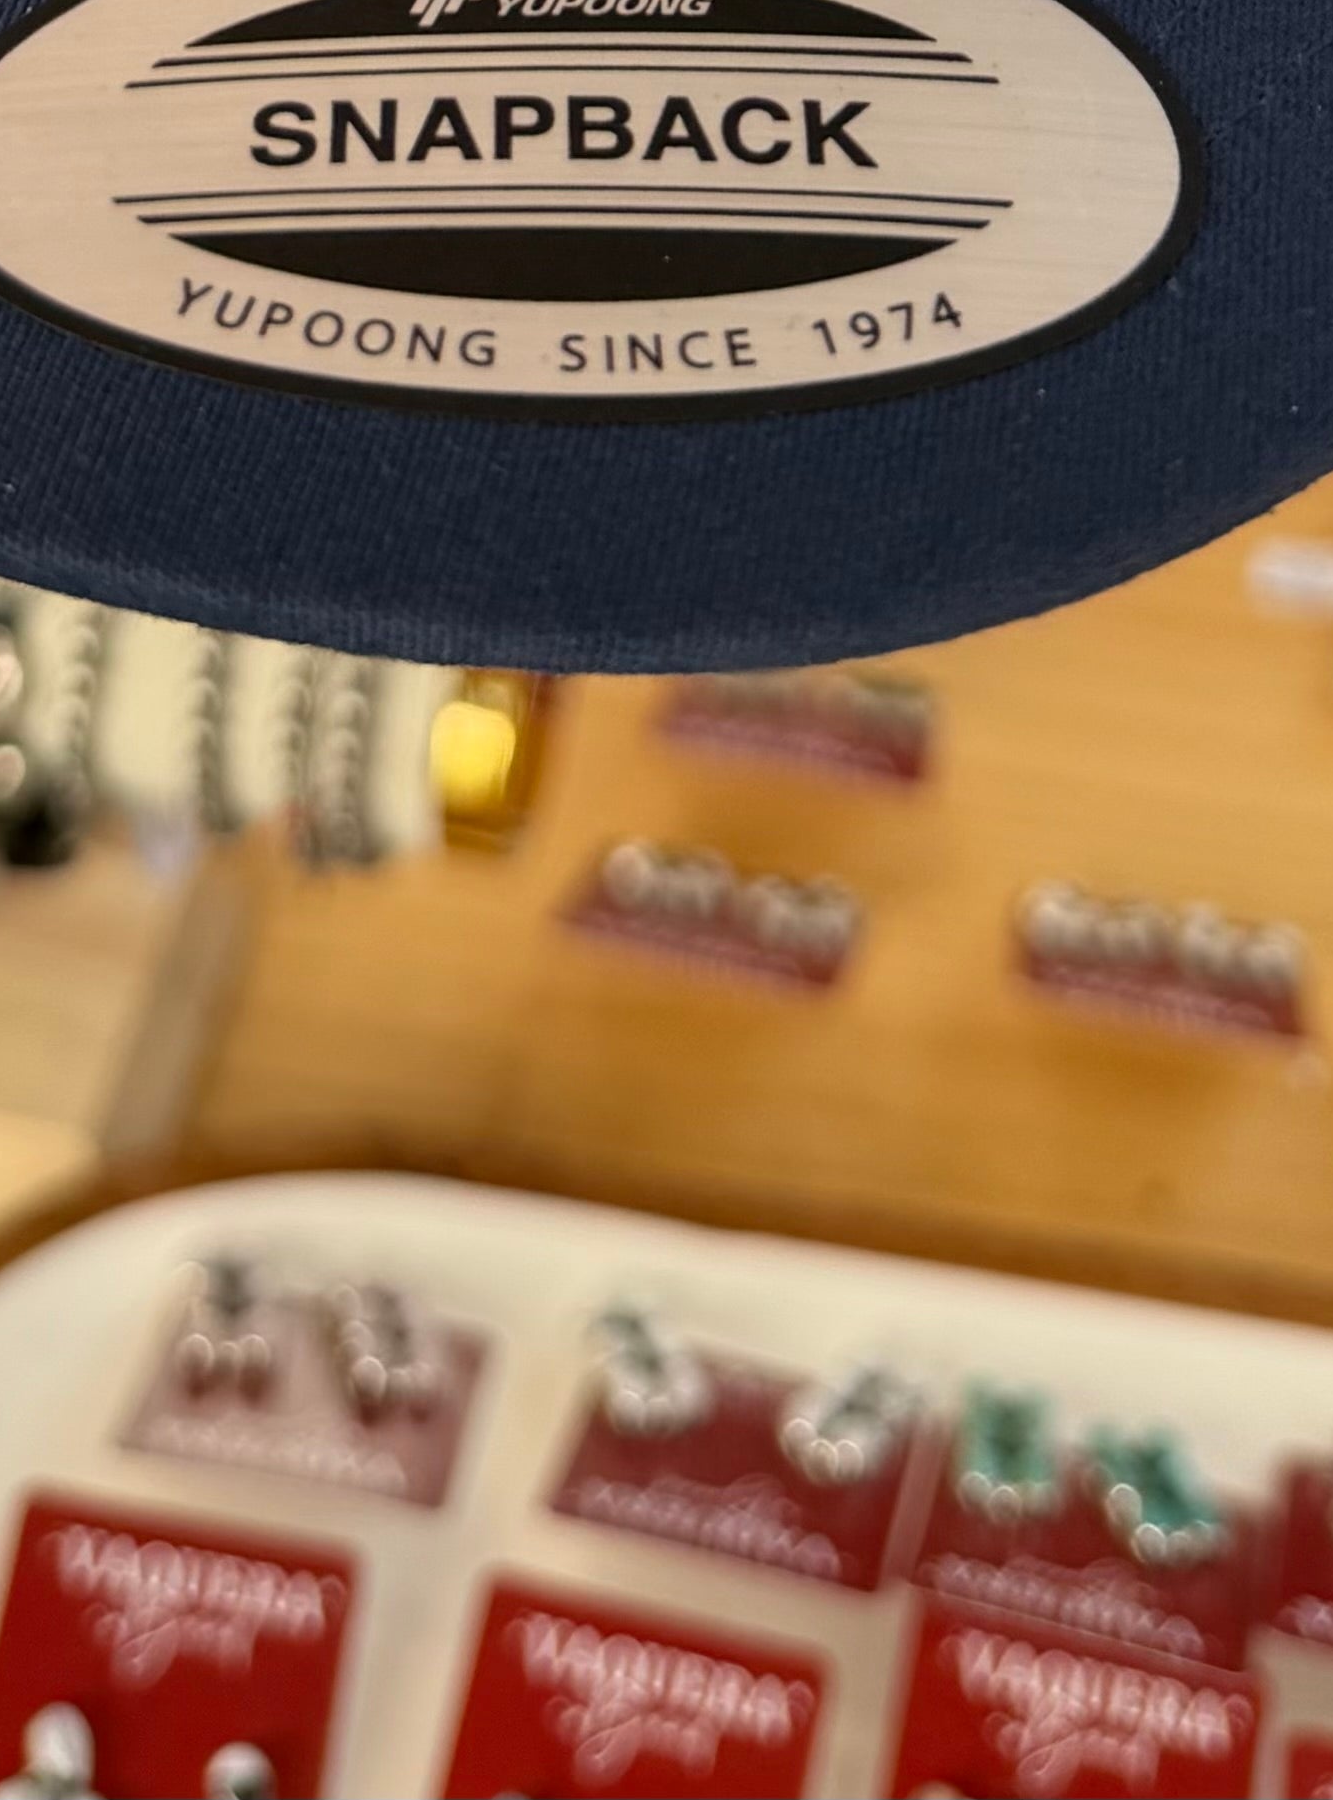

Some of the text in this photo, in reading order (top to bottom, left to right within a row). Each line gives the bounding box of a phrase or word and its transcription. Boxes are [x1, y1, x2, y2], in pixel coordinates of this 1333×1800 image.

[251, 96, 879, 169] SNAPBACK
[175, 278, 964, 374] YUPOONG SINCE 1974
